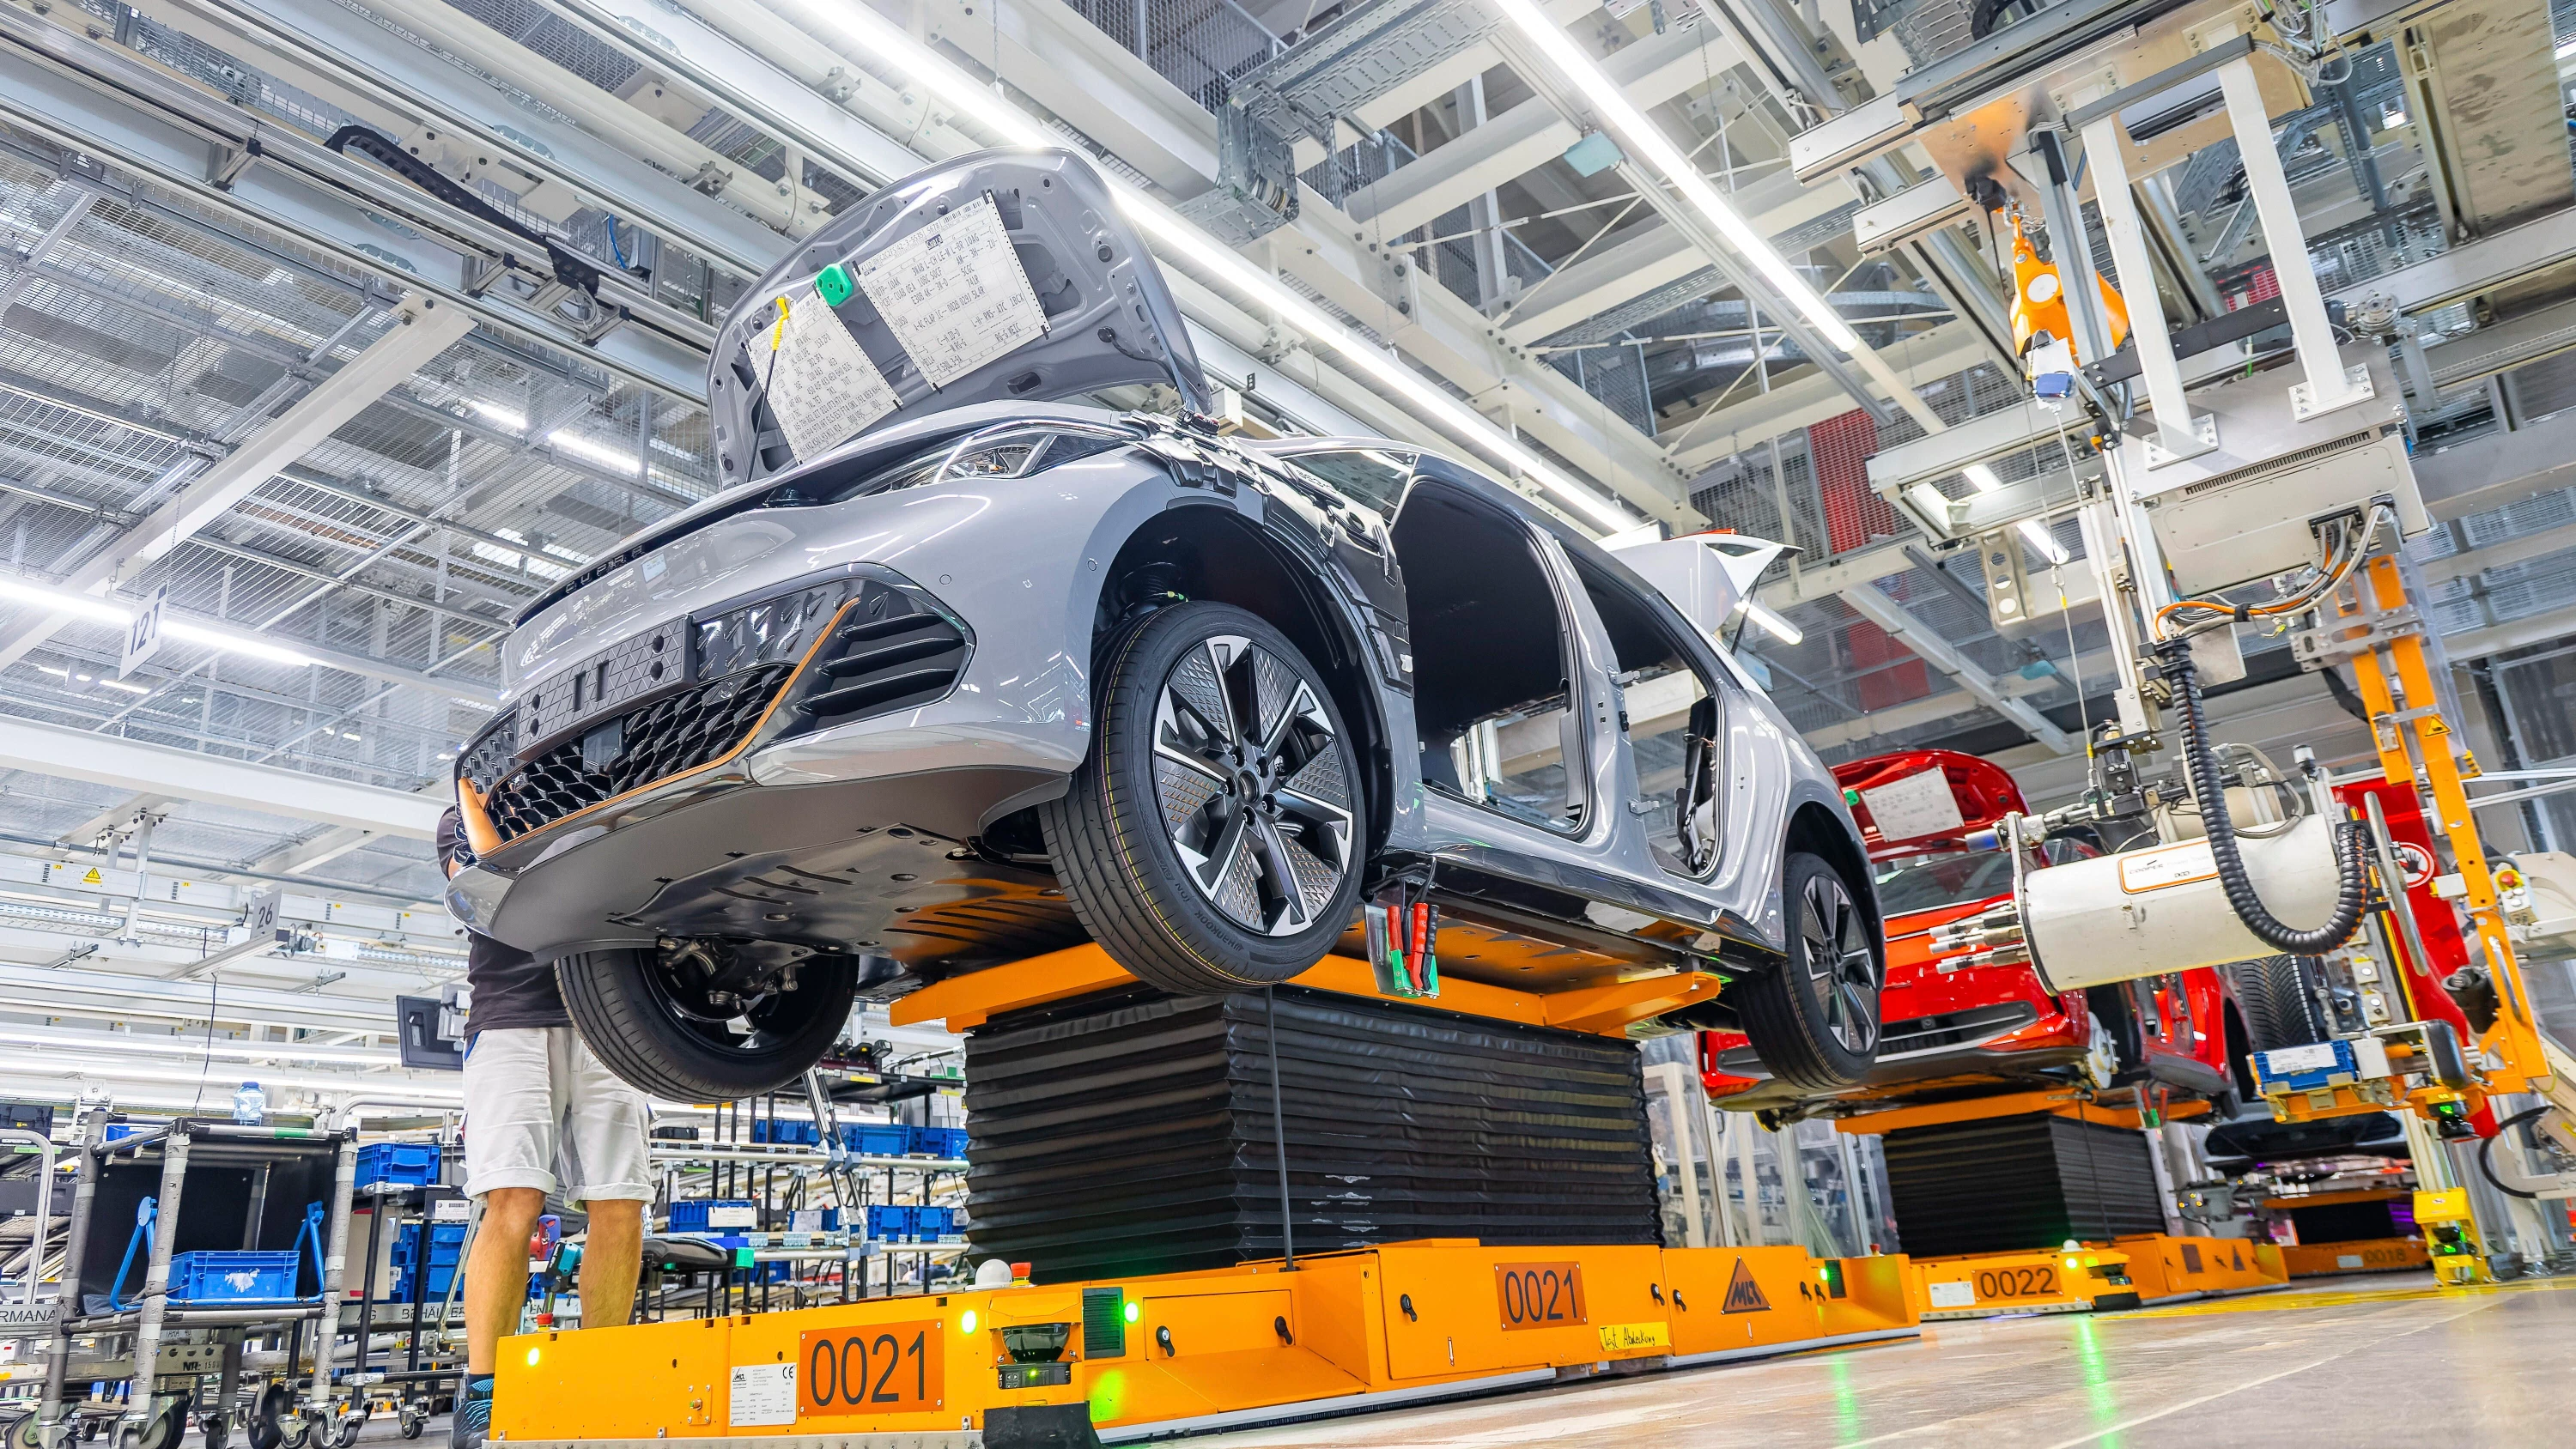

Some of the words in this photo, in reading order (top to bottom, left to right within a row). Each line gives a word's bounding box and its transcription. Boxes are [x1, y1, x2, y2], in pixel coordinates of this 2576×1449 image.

[131, 602, 160, 656] 121
[257, 902, 274, 930] 26
[1504, 1269, 1577, 1324] 0021
[1980, 1267, 2057, 1298] 0022
[1600, 1326, 1619, 1350] Test
[811, 1331, 925, 1407] 0021
